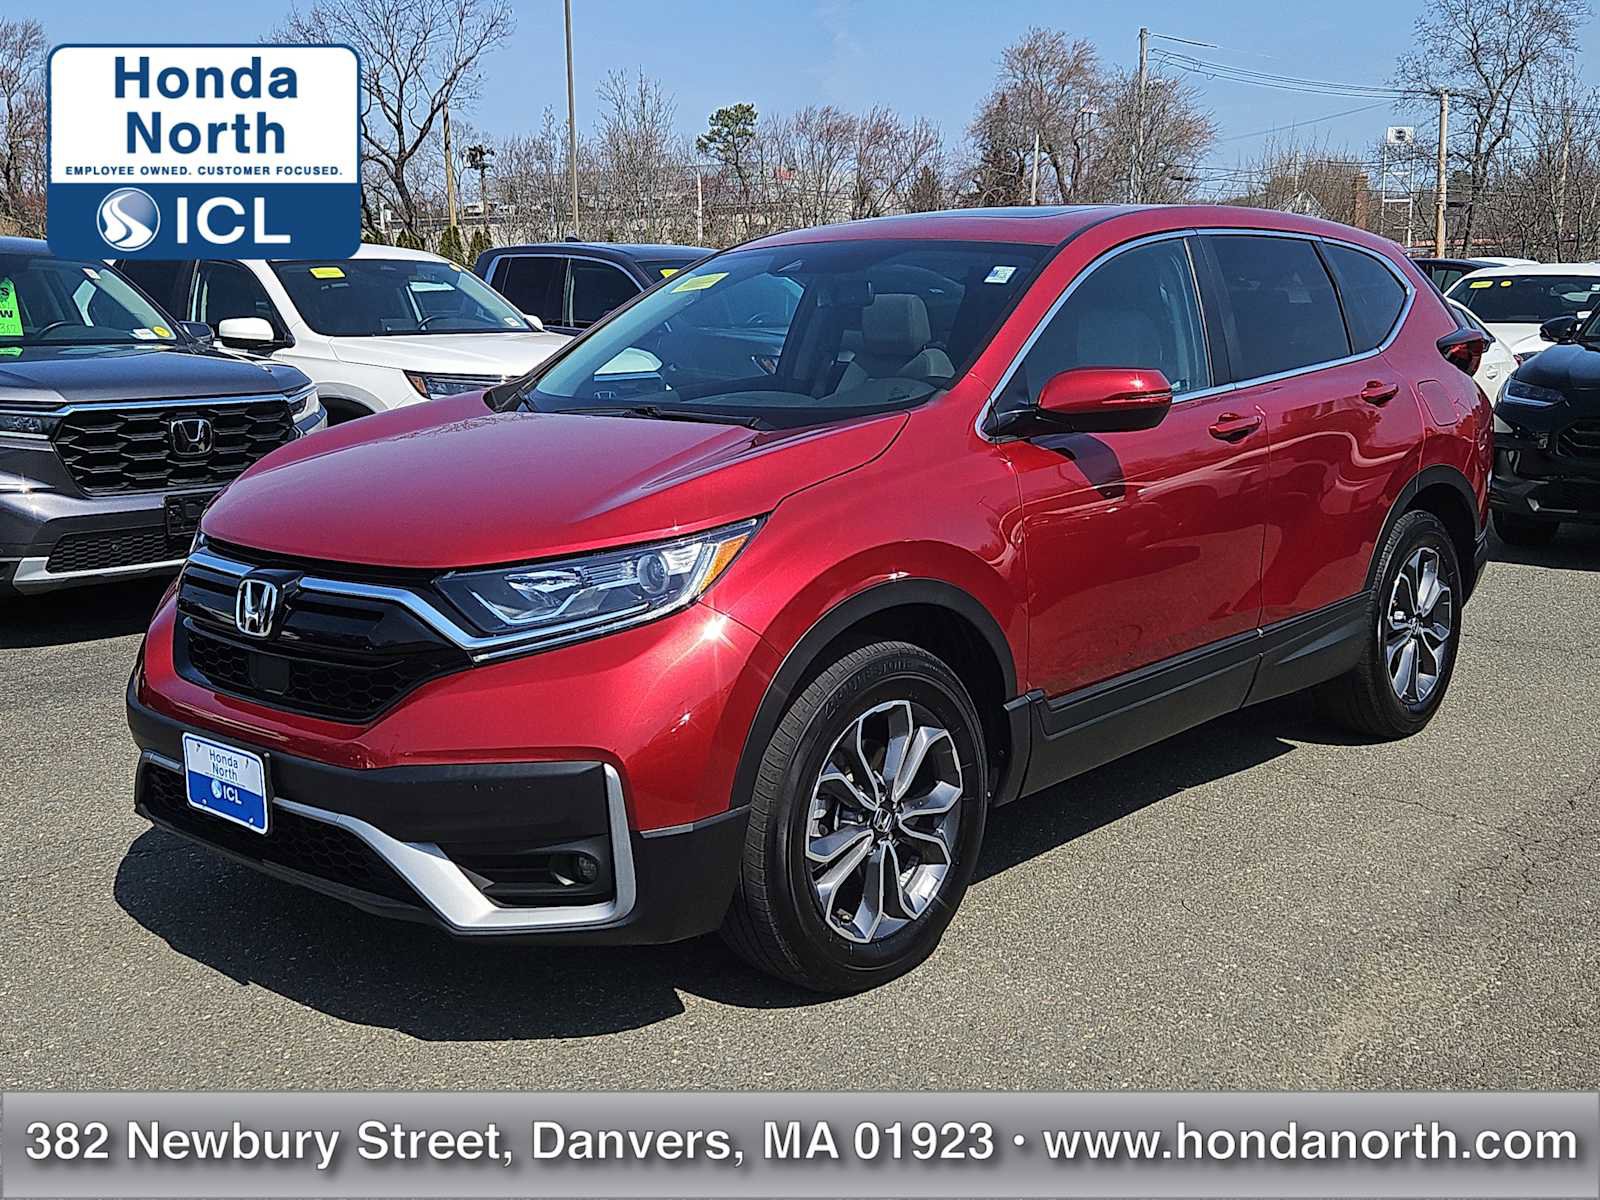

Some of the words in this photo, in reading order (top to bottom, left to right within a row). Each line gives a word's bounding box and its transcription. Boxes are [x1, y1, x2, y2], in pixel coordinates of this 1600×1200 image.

[209, 749, 239, 768] Honda
[212, 762, 238, 781] North
[223, 783, 242, 805] ICL
